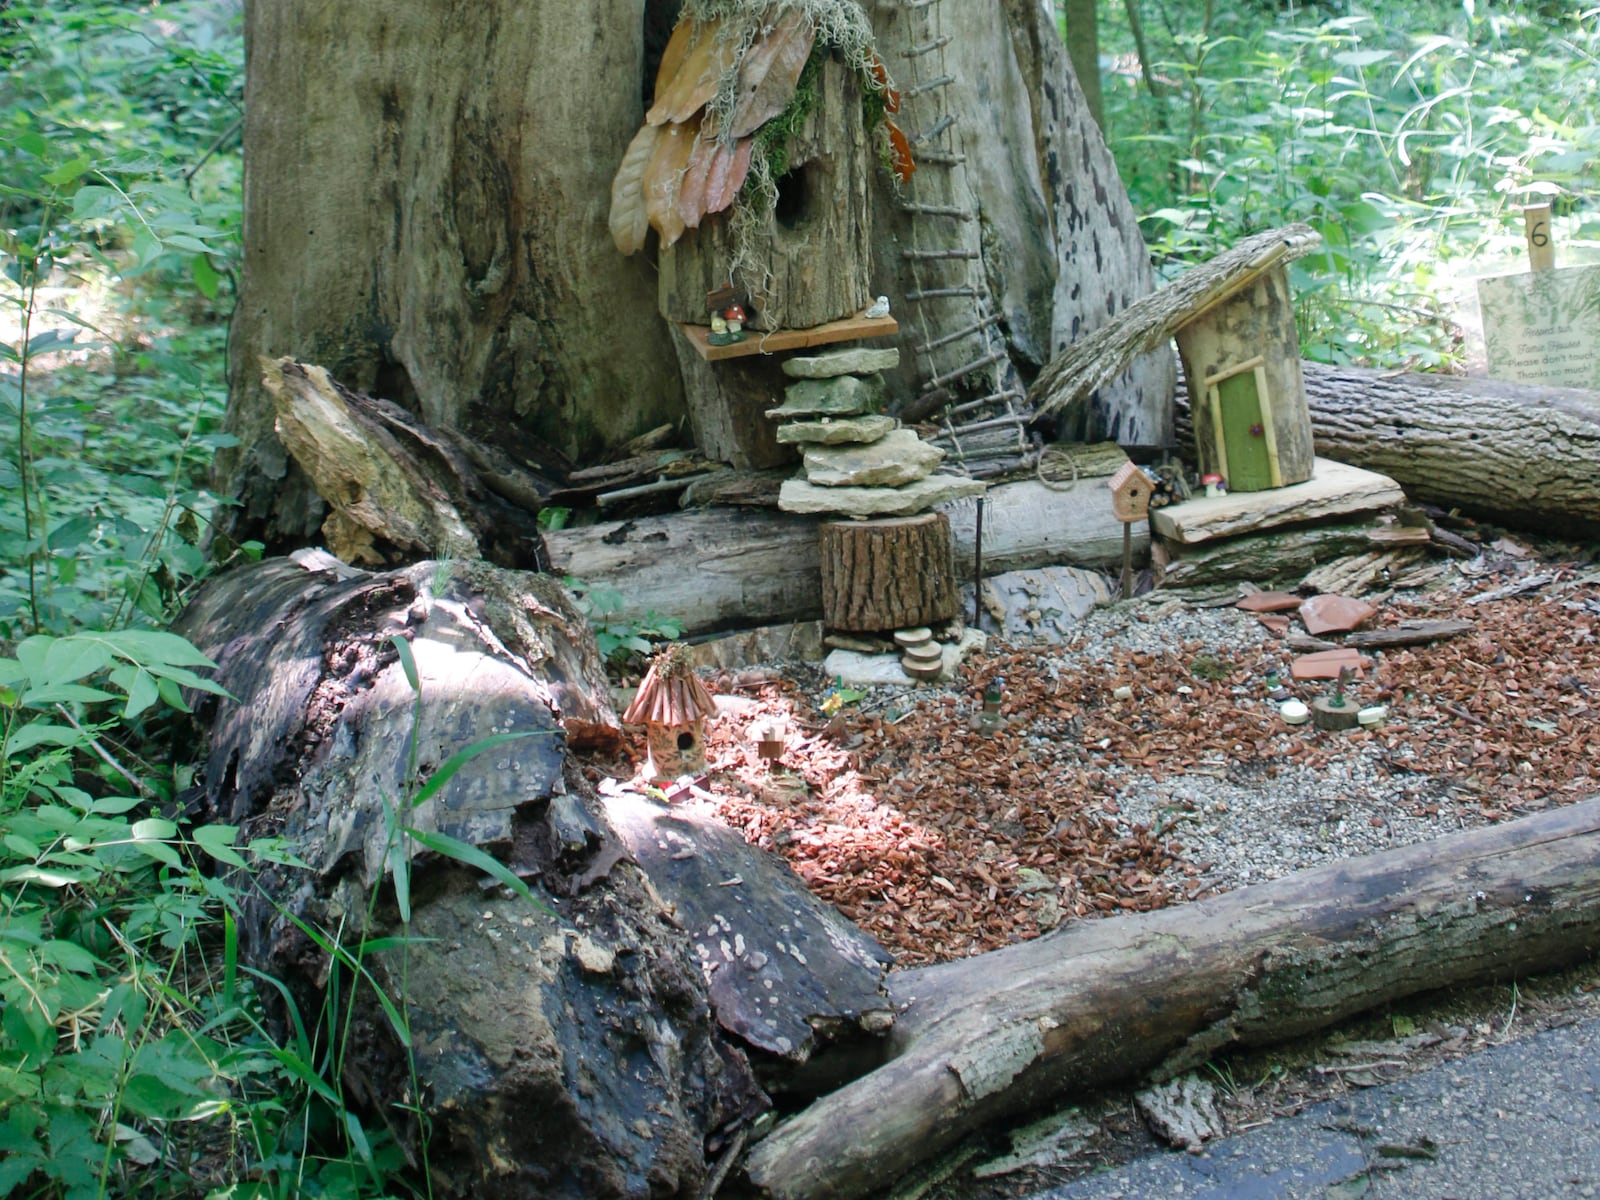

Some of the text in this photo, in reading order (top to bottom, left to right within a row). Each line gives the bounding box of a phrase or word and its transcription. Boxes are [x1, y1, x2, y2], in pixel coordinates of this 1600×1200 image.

[1531, 221, 1548, 248] 6
[1507, 358, 1539, 367] Please
[1542, 354, 1566, 365] don't
[1517, 368, 1548, 379] Thanks
